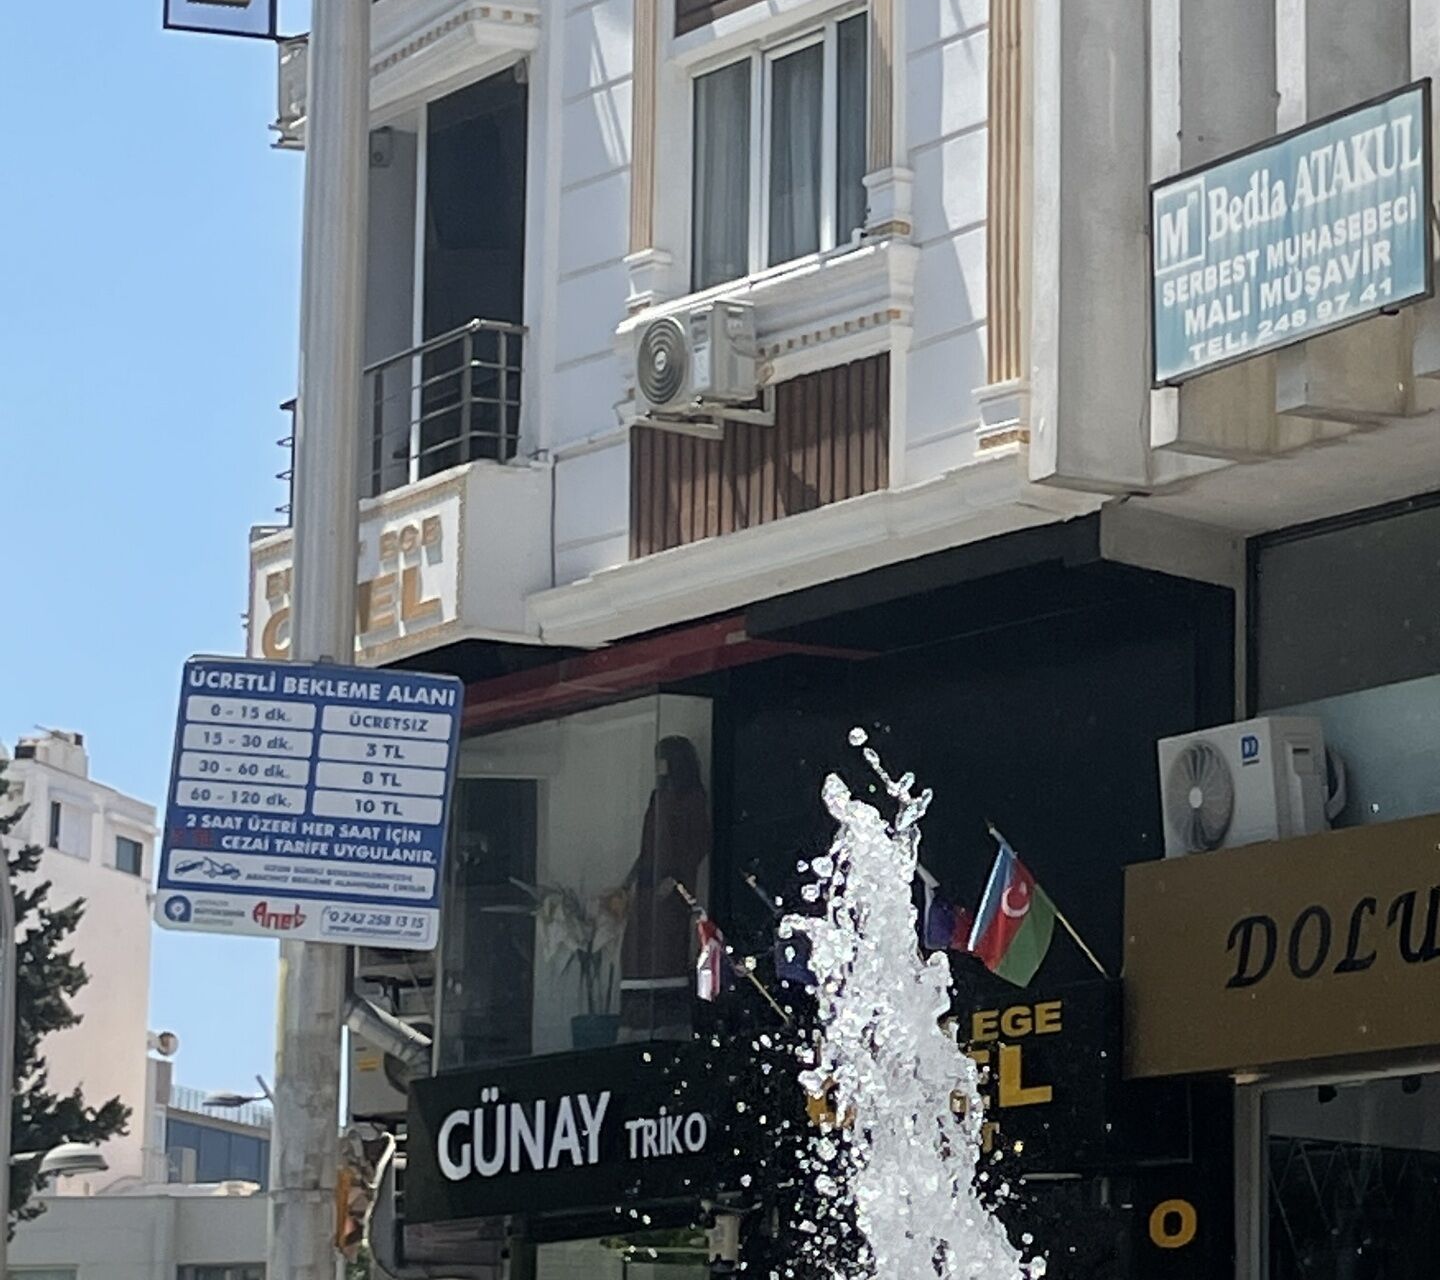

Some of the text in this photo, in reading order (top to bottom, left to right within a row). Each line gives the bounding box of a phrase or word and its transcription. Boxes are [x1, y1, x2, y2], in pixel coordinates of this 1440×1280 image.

[1292, 114, 1423, 212] ATAKUL
[1163, 185, 1418, 308] SERBEST MUHASEBECİ
[1184, 239, 1392, 336] MALİ MÜŞAVİR
[1257, 308, 1308, 340] 248
[1316, 292, 1351, 320] 97
[1359, 278, 1393, 303] 41
[189, 665, 456, 707] ÜCRETLİ BEKLEME ALANI
[240, 705, 260, 720] 15
[203, 730, 222, 746] 15
[241, 733, 262, 748] 30
[266, 735, 293, 751] dk.
[366, 743, 405, 759] 3 TL
[198, 759, 219, 774] 30
[238, 761, 258, 776] 60
[263, 764, 290, 780] dk.
[362, 771, 402, 788] 8 TL
[190, 787, 211, 802] 60
[230, 789, 261, 805] 120
[355, 798, 403, 816] 10 TL
[186, 814, 198, 828] 2
[201, 814, 244, 829] SAAT
[247, 815, 297, 835] ÜZERİ
[338, 826, 381, 842] SAAT
[221, 833, 269, 850] CEZAİ
[274, 837, 329, 856] TARİFE
[333, 842, 438, 864] UYGULANIR.
[971, 999, 1064, 1042] EGE
[437, 1088, 707, 1182] GÜNAY TRİKO
